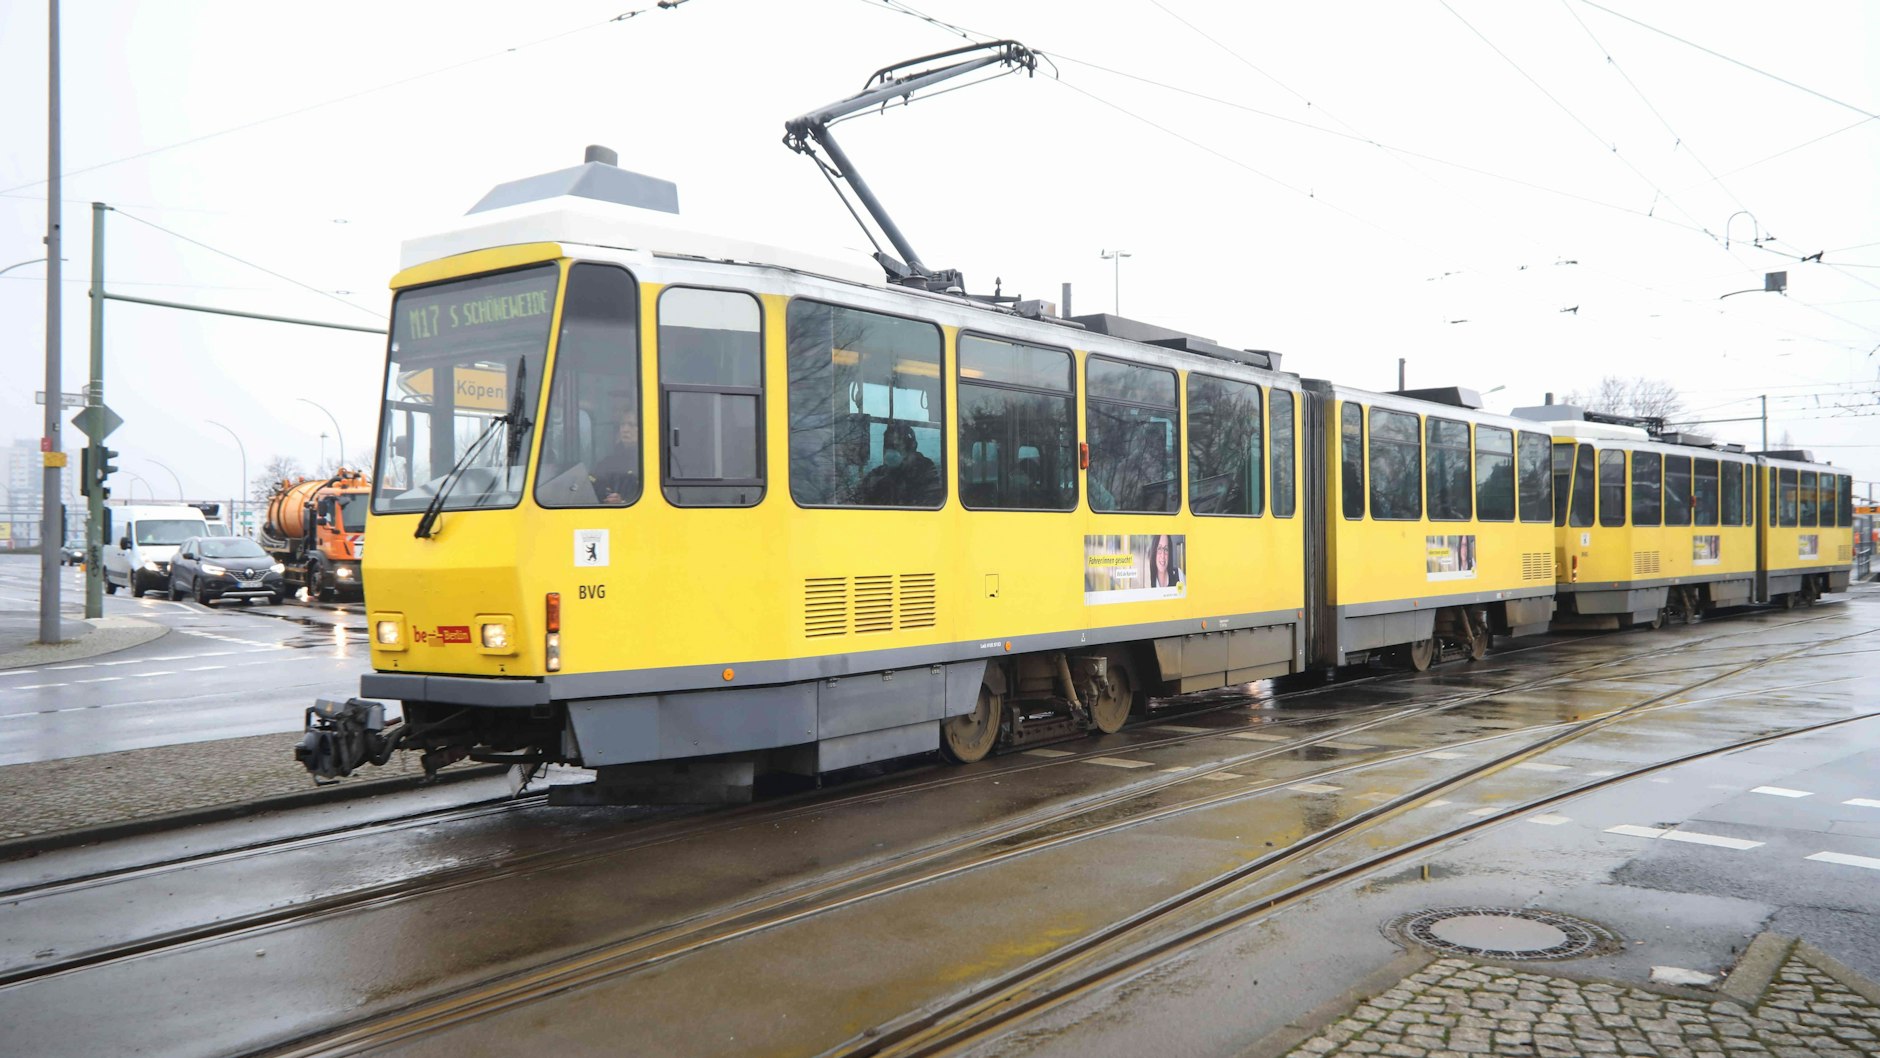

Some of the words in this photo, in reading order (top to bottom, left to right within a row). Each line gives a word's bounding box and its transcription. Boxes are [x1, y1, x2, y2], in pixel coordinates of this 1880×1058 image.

[409, 304, 439, 340] M17
[450, 305, 459, 327] S
[578, 584, 606, 599] BVG
